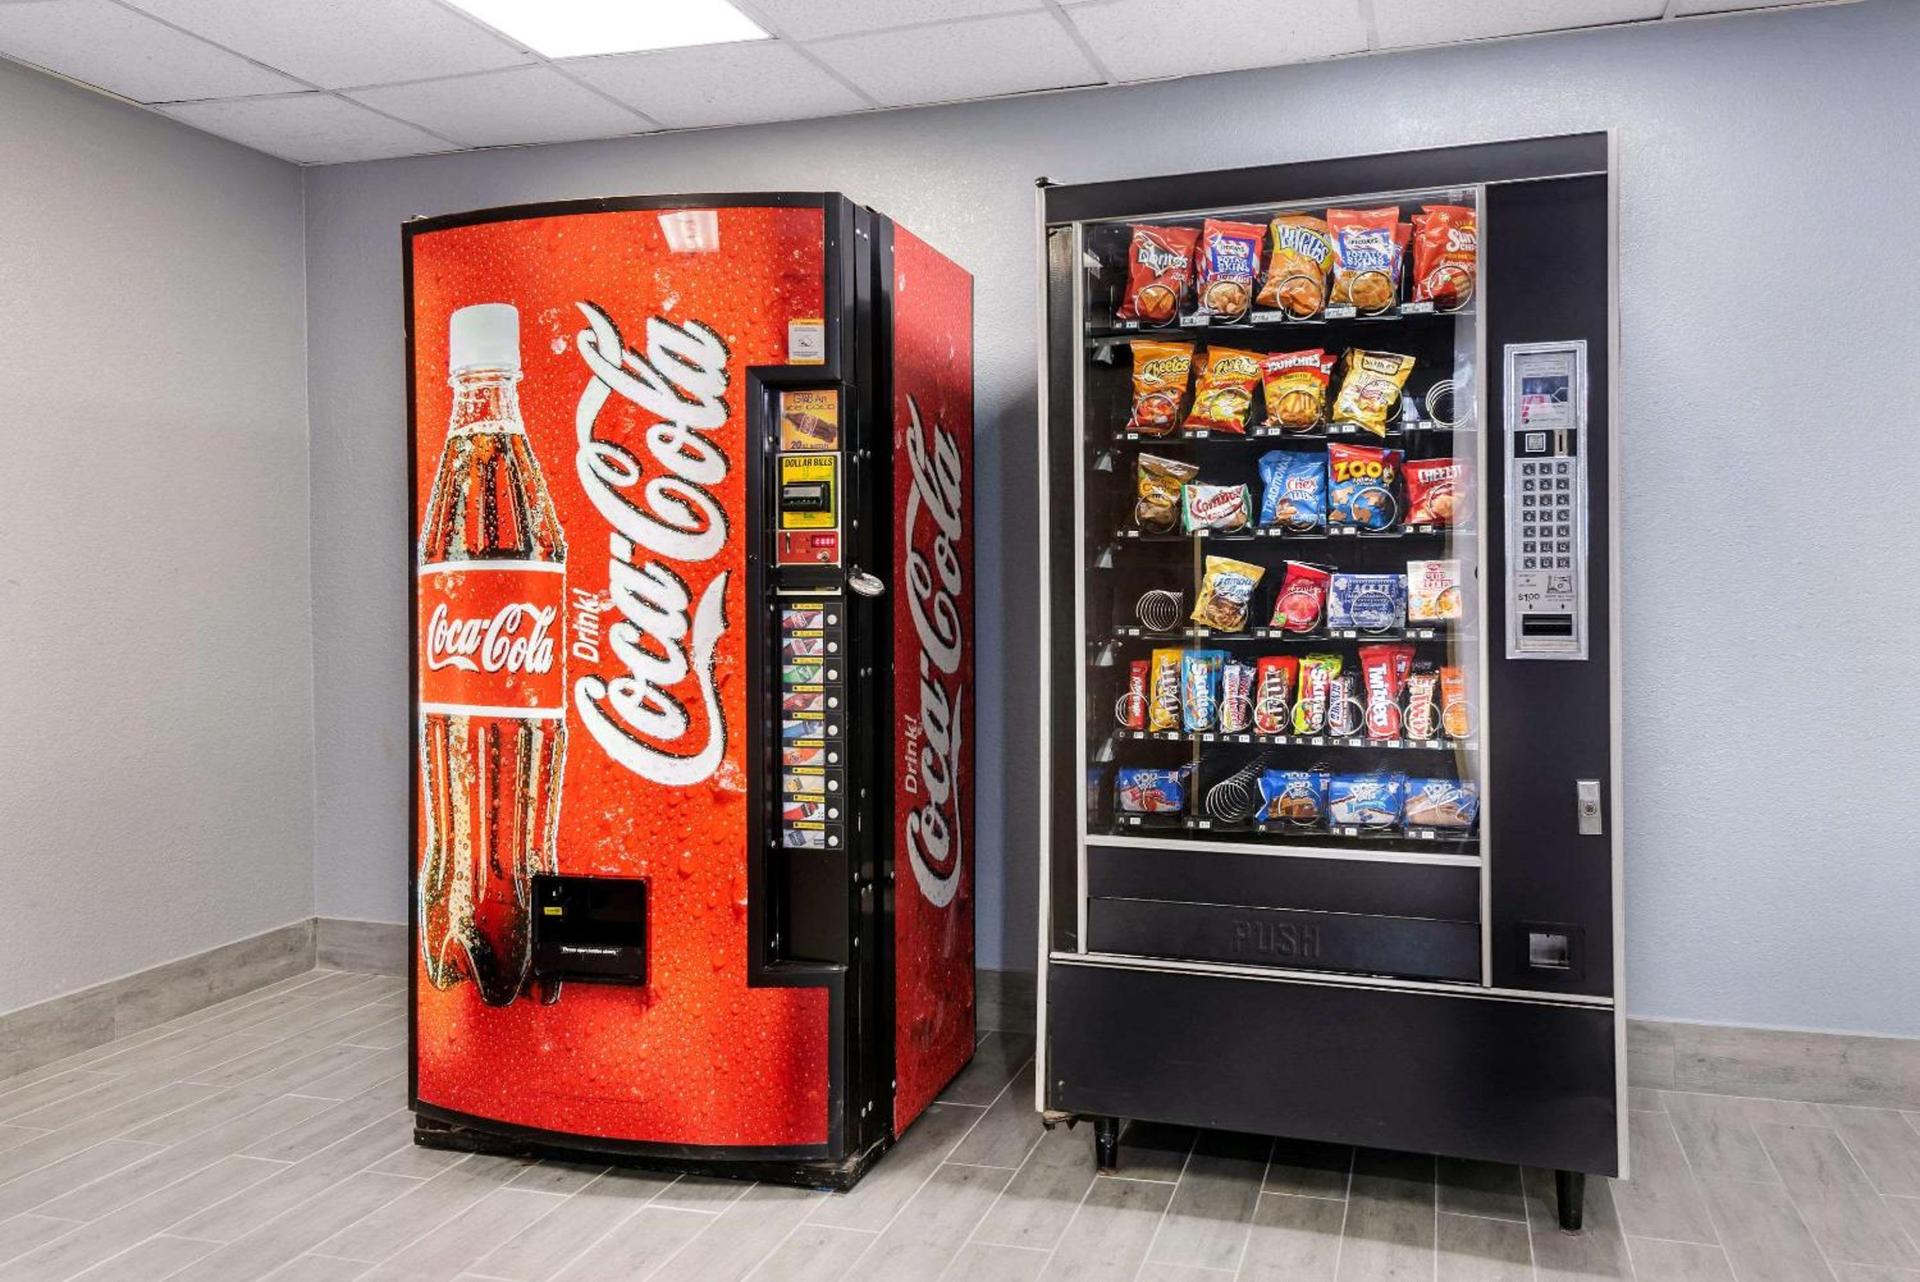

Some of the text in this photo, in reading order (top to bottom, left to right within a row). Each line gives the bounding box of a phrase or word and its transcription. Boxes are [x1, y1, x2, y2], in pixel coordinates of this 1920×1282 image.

[1143, 355, 1191, 384] Cheetos
[784, 458, 833, 467] DOLLAR BILLS
[1333, 460, 1384, 484] ZOO
[575, 300, 732, 787] Coca-Cola
[428, 602, 557, 675] Coca-Cola
[572, 587, 602, 665] Drink!
[906, 394, 963, 908] Coca-Cola
[904, 714, 920, 795] Drink!
[1232, 920, 1321, 957] PUSH
